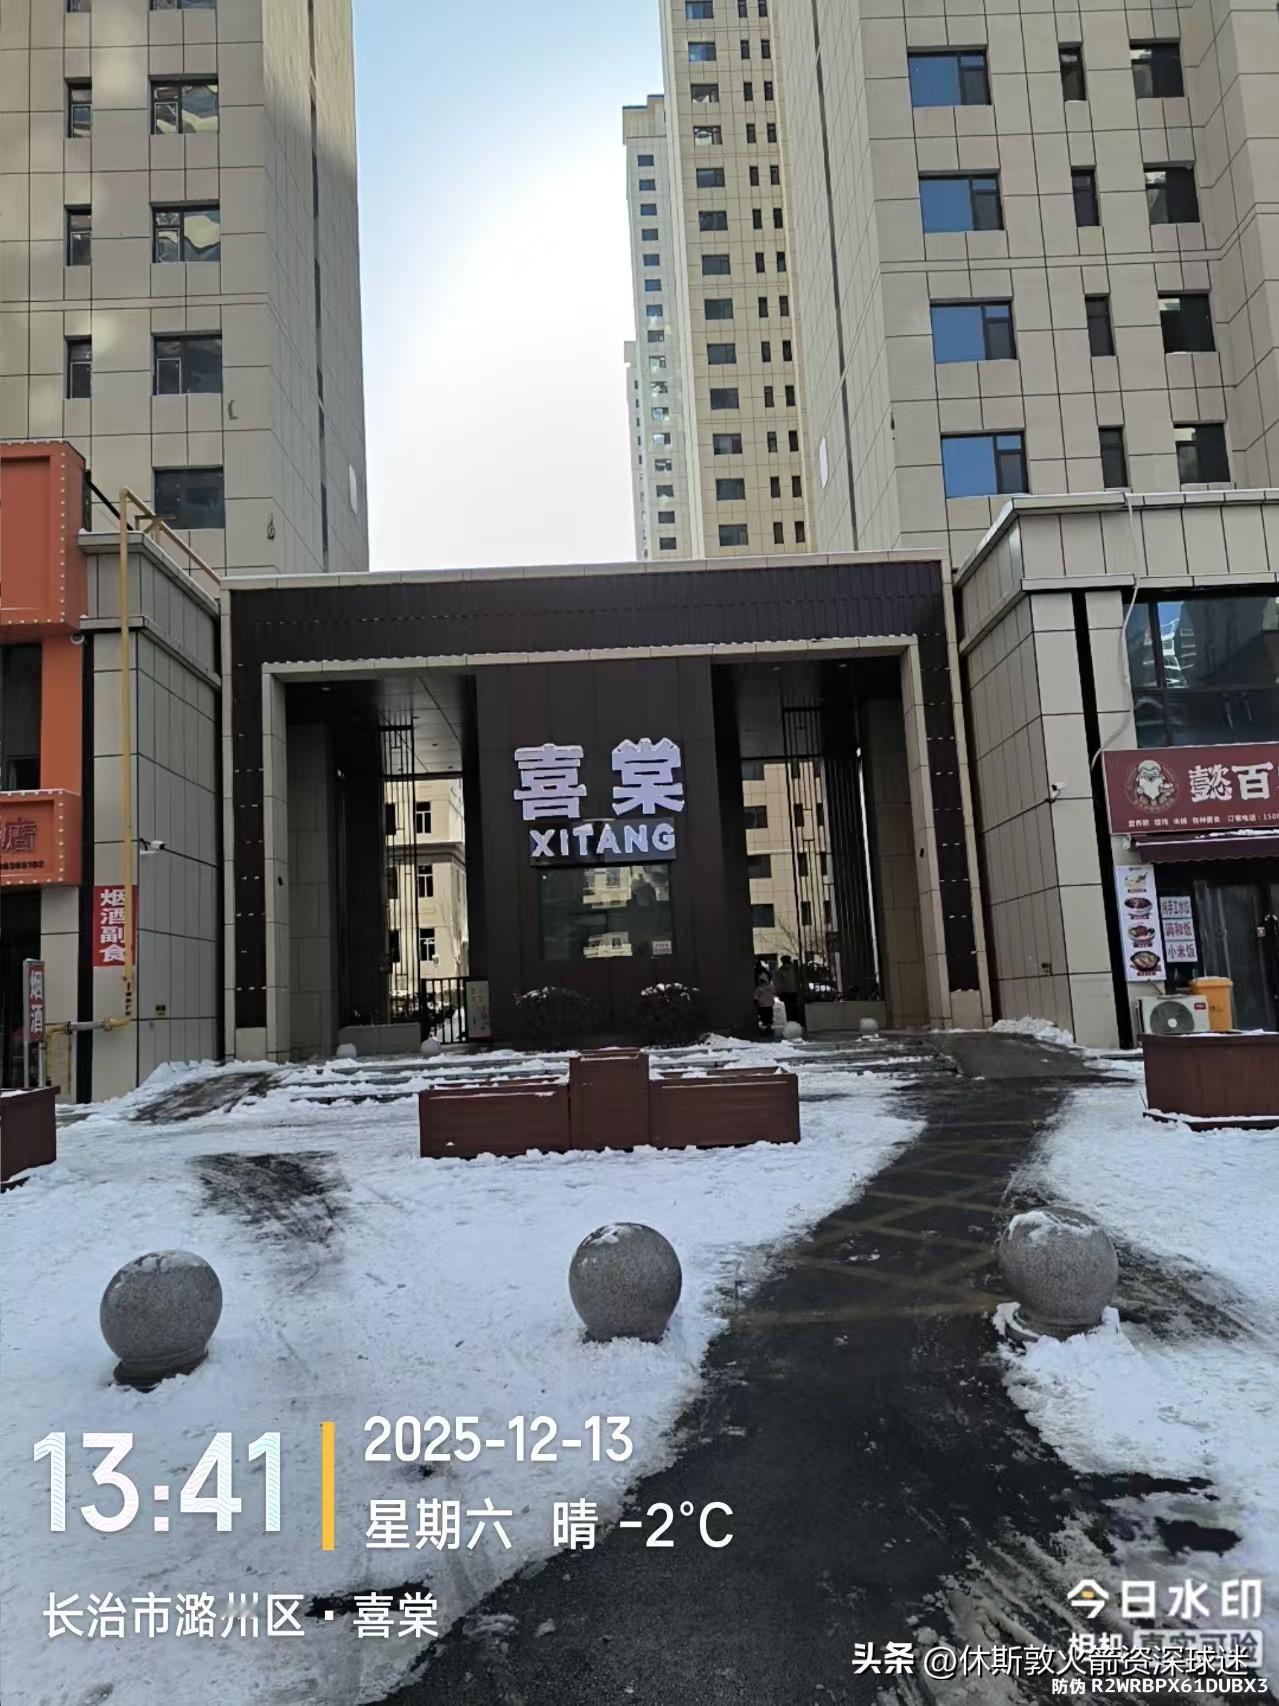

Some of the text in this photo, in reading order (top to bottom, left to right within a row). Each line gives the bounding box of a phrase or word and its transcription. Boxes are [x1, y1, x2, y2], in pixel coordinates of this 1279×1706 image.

[513, 737, 685, 820] 喜棠
[1188, 761, 1279, 803] 懿百
[529, 823, 676, 857] XITANG
[99, 889, 126, 962] 烟酒副食
